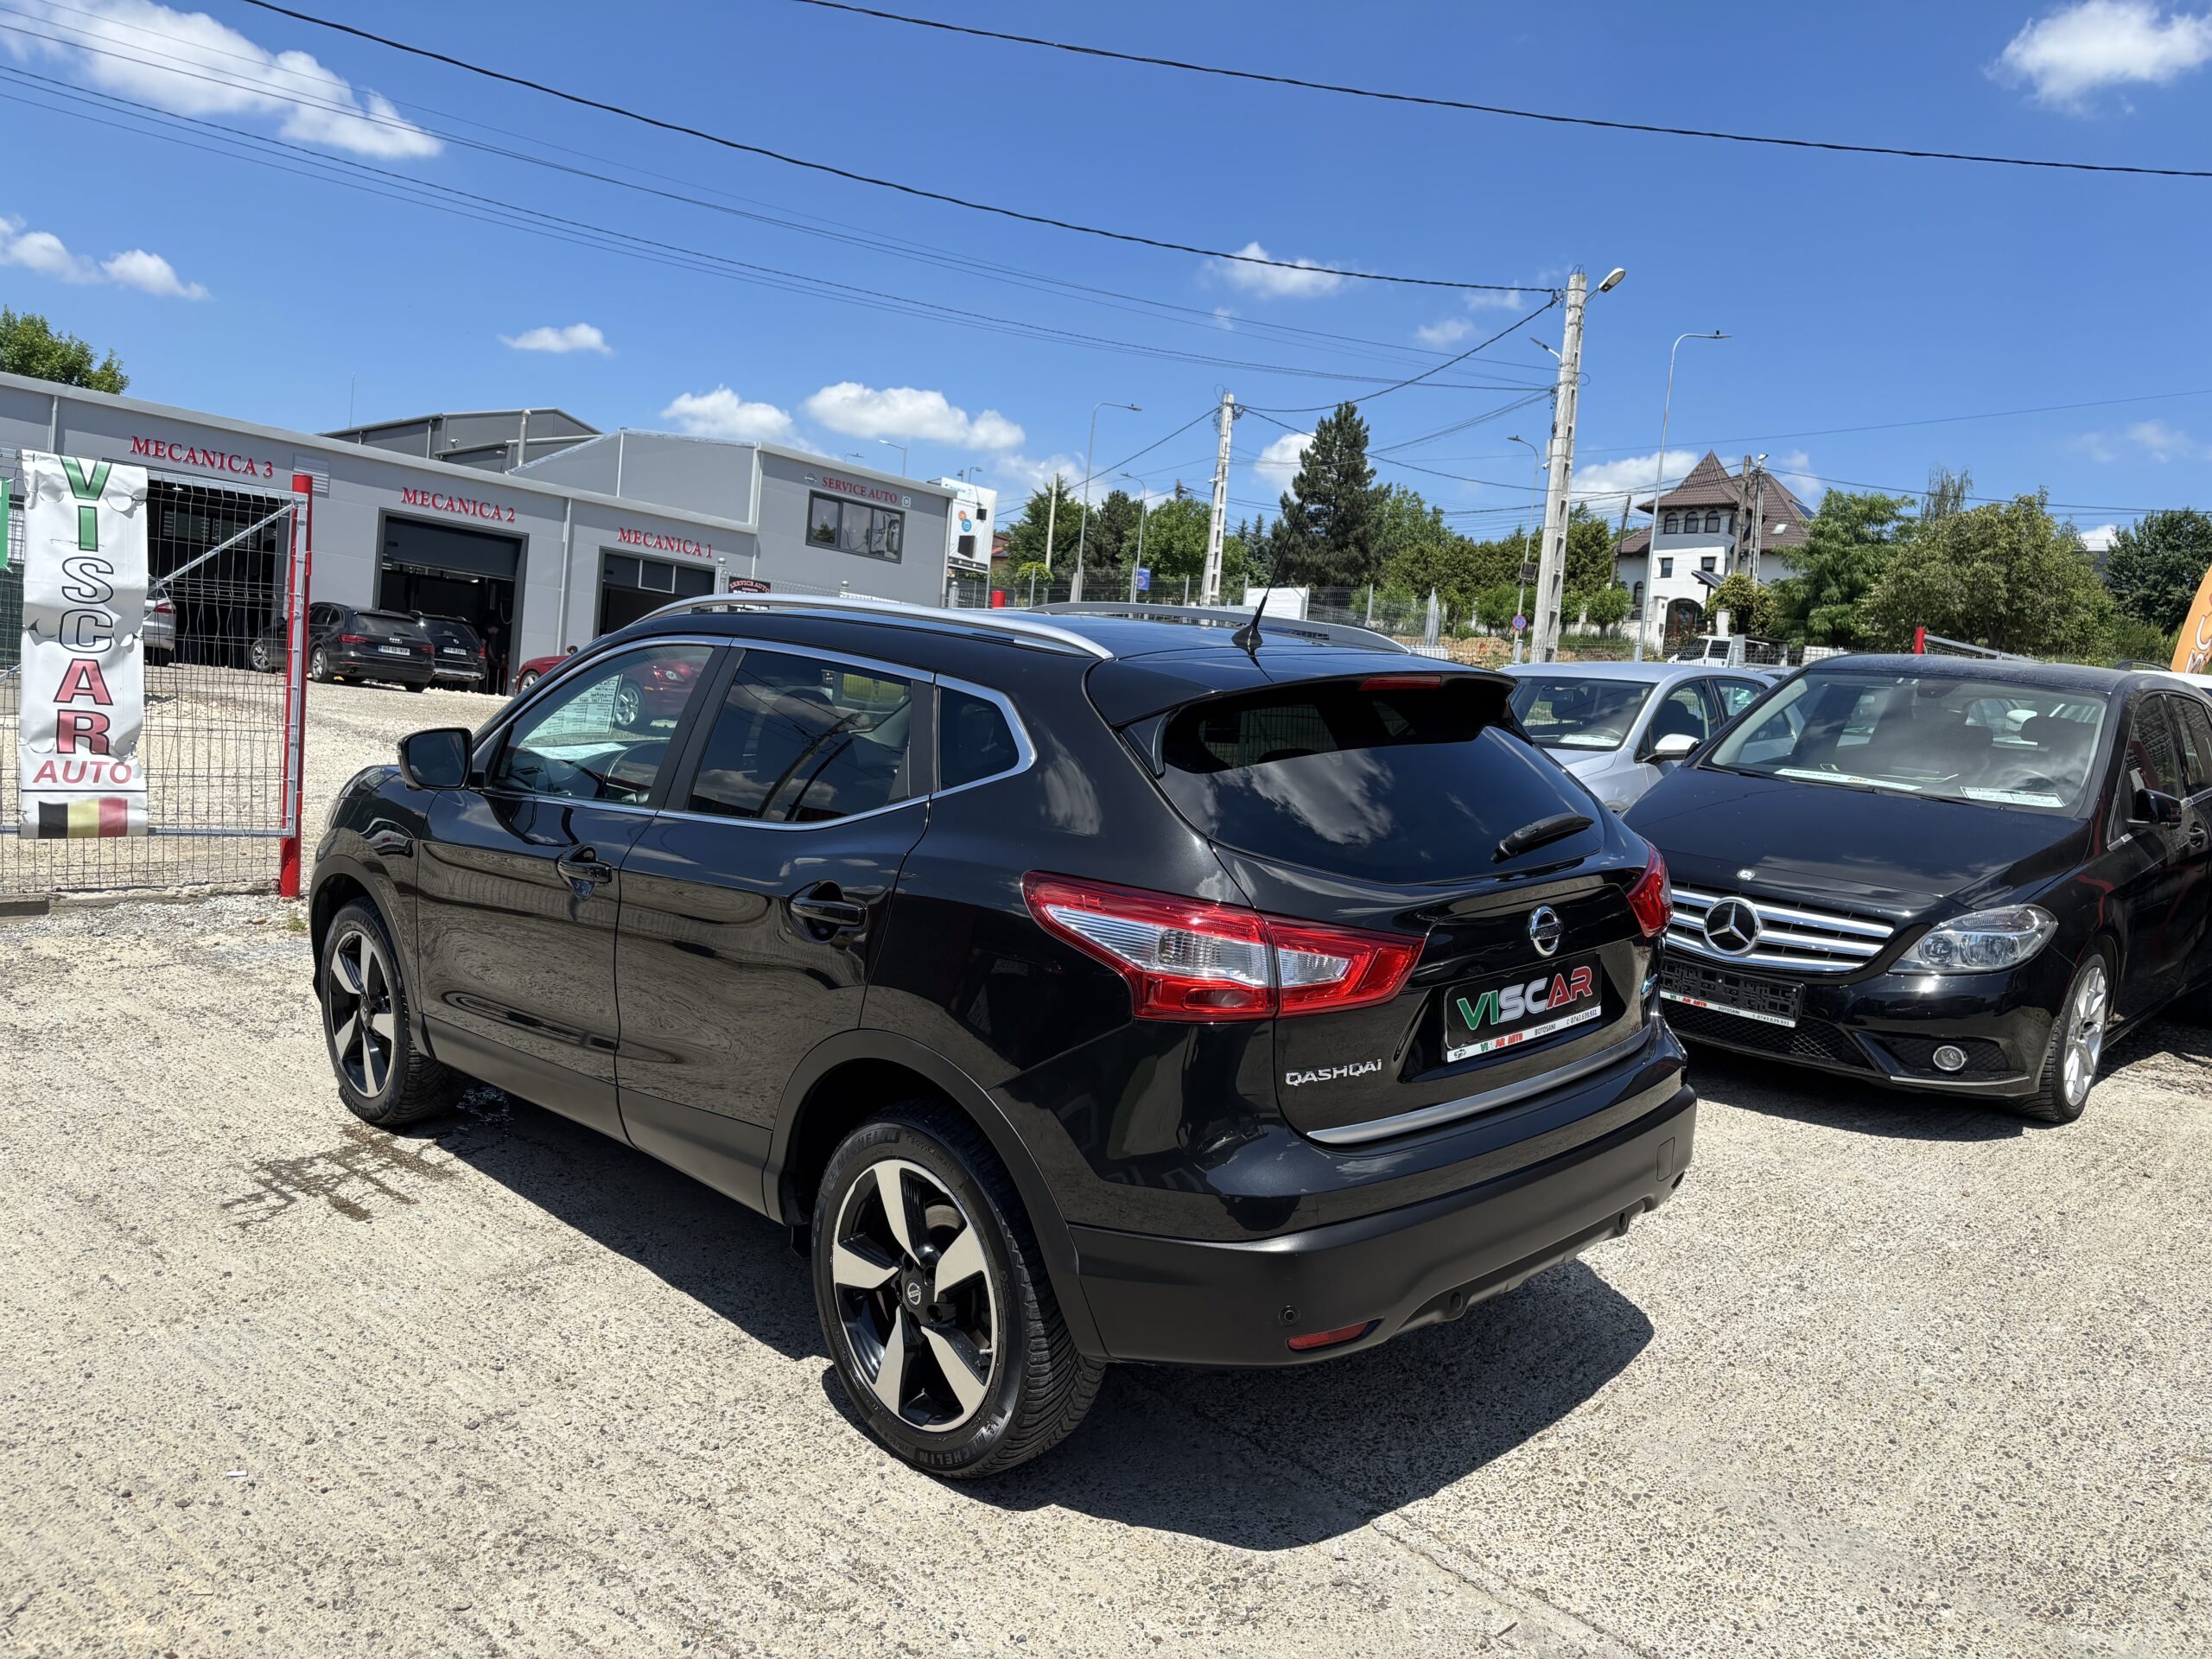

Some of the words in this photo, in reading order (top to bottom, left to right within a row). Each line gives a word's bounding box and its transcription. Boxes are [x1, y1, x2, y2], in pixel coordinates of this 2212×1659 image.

[130, 435, 257, 475] MECANICA
[263, 461, 274, 478] 3
[401, 486, 502, 520] MECANICA
[503, 507, 515, 523] 2
[822, 476, 867, 497] SERVICE
[868, 488, 898, 504] AUTO
[618, 527, 702, 556] MECANICA
[705, 543, 713, 558] 1
[54, 455, 113, 755] VISCAR
[33, 760, 132, 785] AUTO
[1456, 965, 1593, 1031] VISCAR
[1535, 1023, 1556, 1036] BOTOSANI
[1285, 1058, 1382, 1086] QASHQAI
[918, 1433, 988, 1465] MICHELIN
